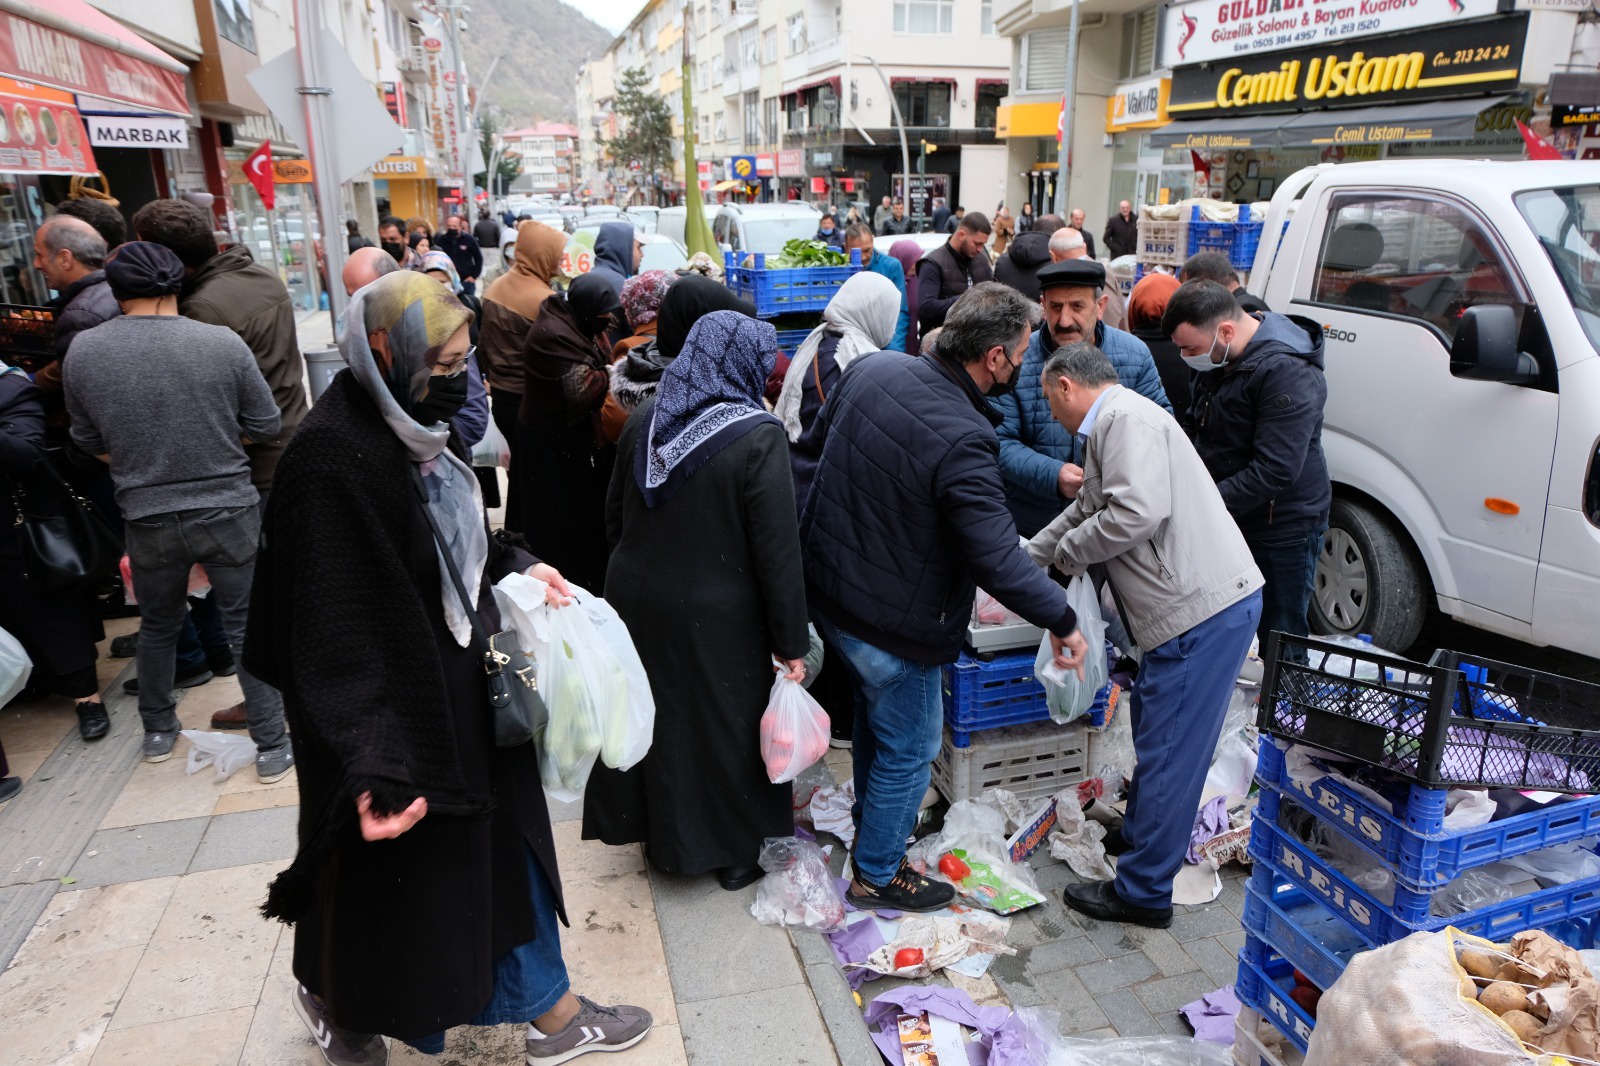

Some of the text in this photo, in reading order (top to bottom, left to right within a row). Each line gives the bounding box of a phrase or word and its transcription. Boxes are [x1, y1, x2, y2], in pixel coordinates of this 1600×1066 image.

[1211, 23, 1253, 42] Güzellik
[1257, 17, 1297, 35] Salonu
[1301, 11, 1310, 26] &
[1315, 6, 1355, 26] Bayan
[1253, 37, 1274, 49] 0505
[1275, 34, 1292, 45] 384
[1294, 29, 1317, 41] 4957
[1340, 23, 1355, 34] 213
[1357, 18, 1381, 31] 1520
[1216, 59, 1301, 109] Cemil
[1304, 50, 1425, 101] Ustam
[1452, 48, 1475, 65] 213
[1474, 46, 1492, 62] 24
[1492, 44, 1510, 60] 24
[97, 126, 183, 144] MARBAK
[1186, 134, 1233, 148] Cemil Ustam
[1334, 126, 1366, 142] Cemil
[1368, 125, 1405, 141] Ustam
[1281, 845, 1372, 926] REiS
